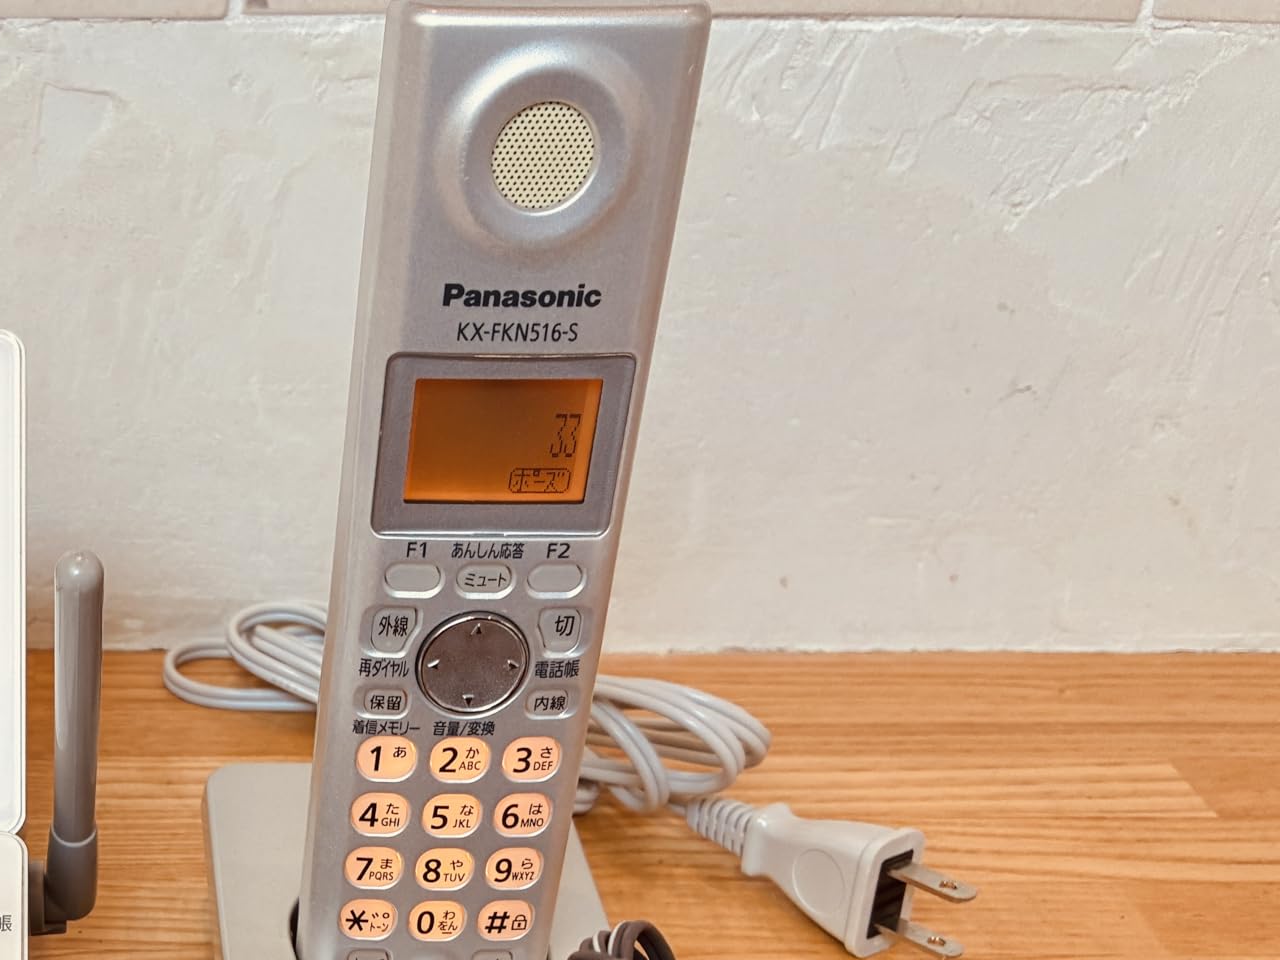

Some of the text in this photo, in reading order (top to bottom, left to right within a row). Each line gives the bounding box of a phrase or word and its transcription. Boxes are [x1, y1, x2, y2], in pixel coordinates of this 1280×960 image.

[442, 283, 602, 308] Panasonic
[456, 322, 578, 342] KX-FKN516-S
[512, 468, 565, 493] ポーズ
[407, 542, 427, 558] F1
[451, 543, 525, 560] あんしん応答
[546, 543, 571, 559] F2
[464, 573, 507, 588] ミュート
[378, 616, 408, 637] 外線
[554, 615, 575, 637] 切
[358, 658, 410, 678] 再ダイヤル
[534, 660, 580, 679] 電話帳
[370, 695, 402, 711] 保留
[534, 695, 566, 711] 内線
[352, 720, 421, 736] 着信メモリー
[433, 720, 496, 737] 音量/変換
[370, 746, 382, 772] 1
[392, 746, 407, 758] あ
[439, 747, 458, 773] 2
[465, 747, 479, 759] か
[512, 747, 532, 773] 3
[540, 746, 553, 759] さ
[458, 761, 481, 771] ABC
[533, 761, 553, 771] DEF
[359, 802, 379, 827] 4
[385, 803, 400, 815] た
[430, 805, 450, 829] 5
[459, 804, 474, 816] な
[501, 803, 520, 829] 6
[528, 803, 543, 815] は
[381, 817, 400, 827] GHI
[453, 818, 471, 828] JKL
[520, 817, 544, 827] MNO
[356, 857, 374, 881] 7
[379, 857, 393, 870] ま
[422, 859, 442, 883] 8
[449, 859, 464, 870] や
[494, 858, 513, 883] 9
[521, 857, 534, 869] ら
[369, 871, 394, 882] PQRS
[443, 872, 465, 882] TUV
[511, 871, 535, 881] WXYZ
[417, 910, 435, 934] 0
[442, 910, 456, 921] わ
[370, 922, 389, 933] トーン
